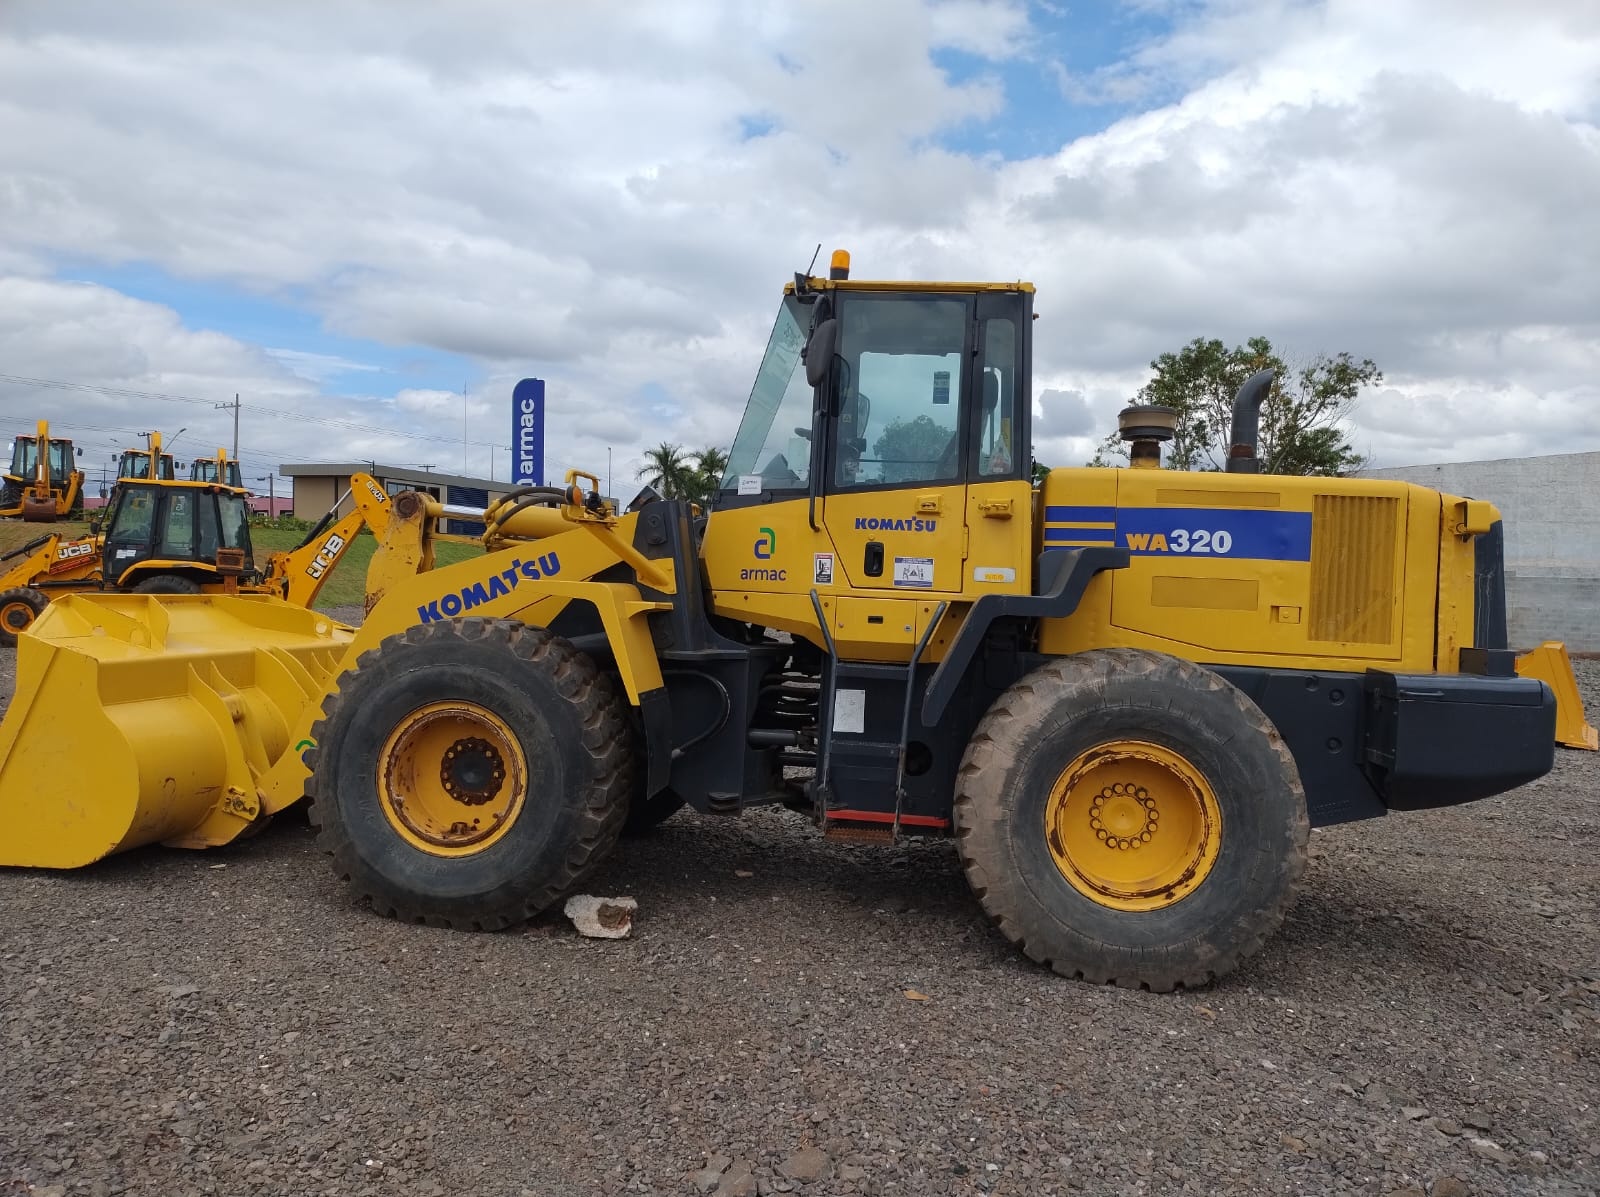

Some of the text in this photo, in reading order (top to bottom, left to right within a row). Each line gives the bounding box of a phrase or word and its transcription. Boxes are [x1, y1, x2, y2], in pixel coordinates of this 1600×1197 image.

[520, 399, 534, 475] armac
[855, 516, 936, 532] KOMATSU
[58, 544, 92, 559] JCB
[1126, 529, 1232, 553] WA320
[305, 534, 345, 578] JCB
[740, 568, 787, 581] armac
[417, 551, 561, 624] KOMATSU
